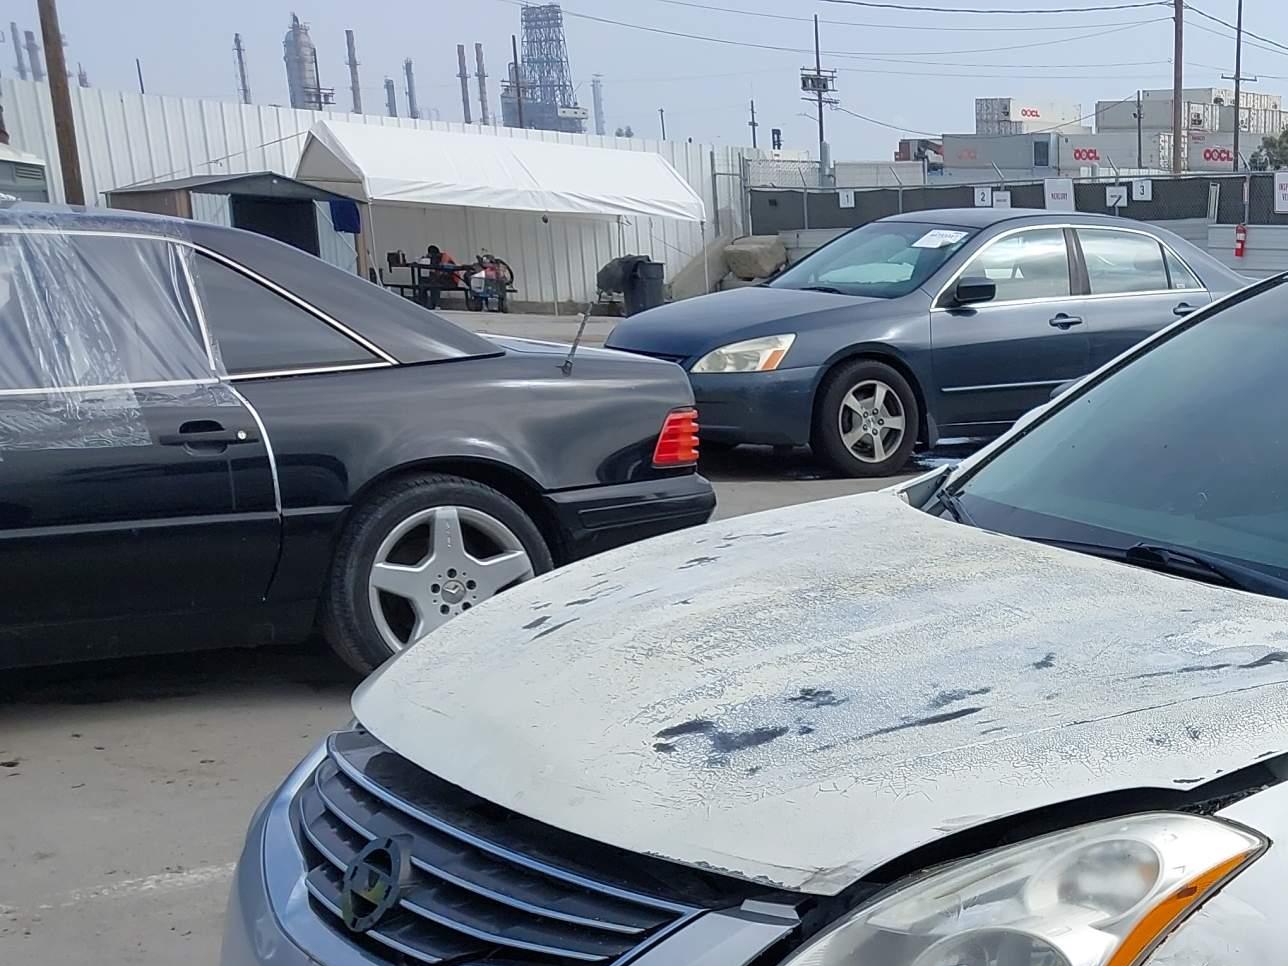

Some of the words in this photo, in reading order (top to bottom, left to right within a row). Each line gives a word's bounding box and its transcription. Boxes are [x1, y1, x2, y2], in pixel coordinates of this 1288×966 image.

[1021, 109, 1040, 117] OOCL
[1073, 149, 1099, 160] OOCL
[1203, 149, 1233, 161] OOCL
[1139, 185, 1145, 195] 3
[980, 192, 986, 201] 2
